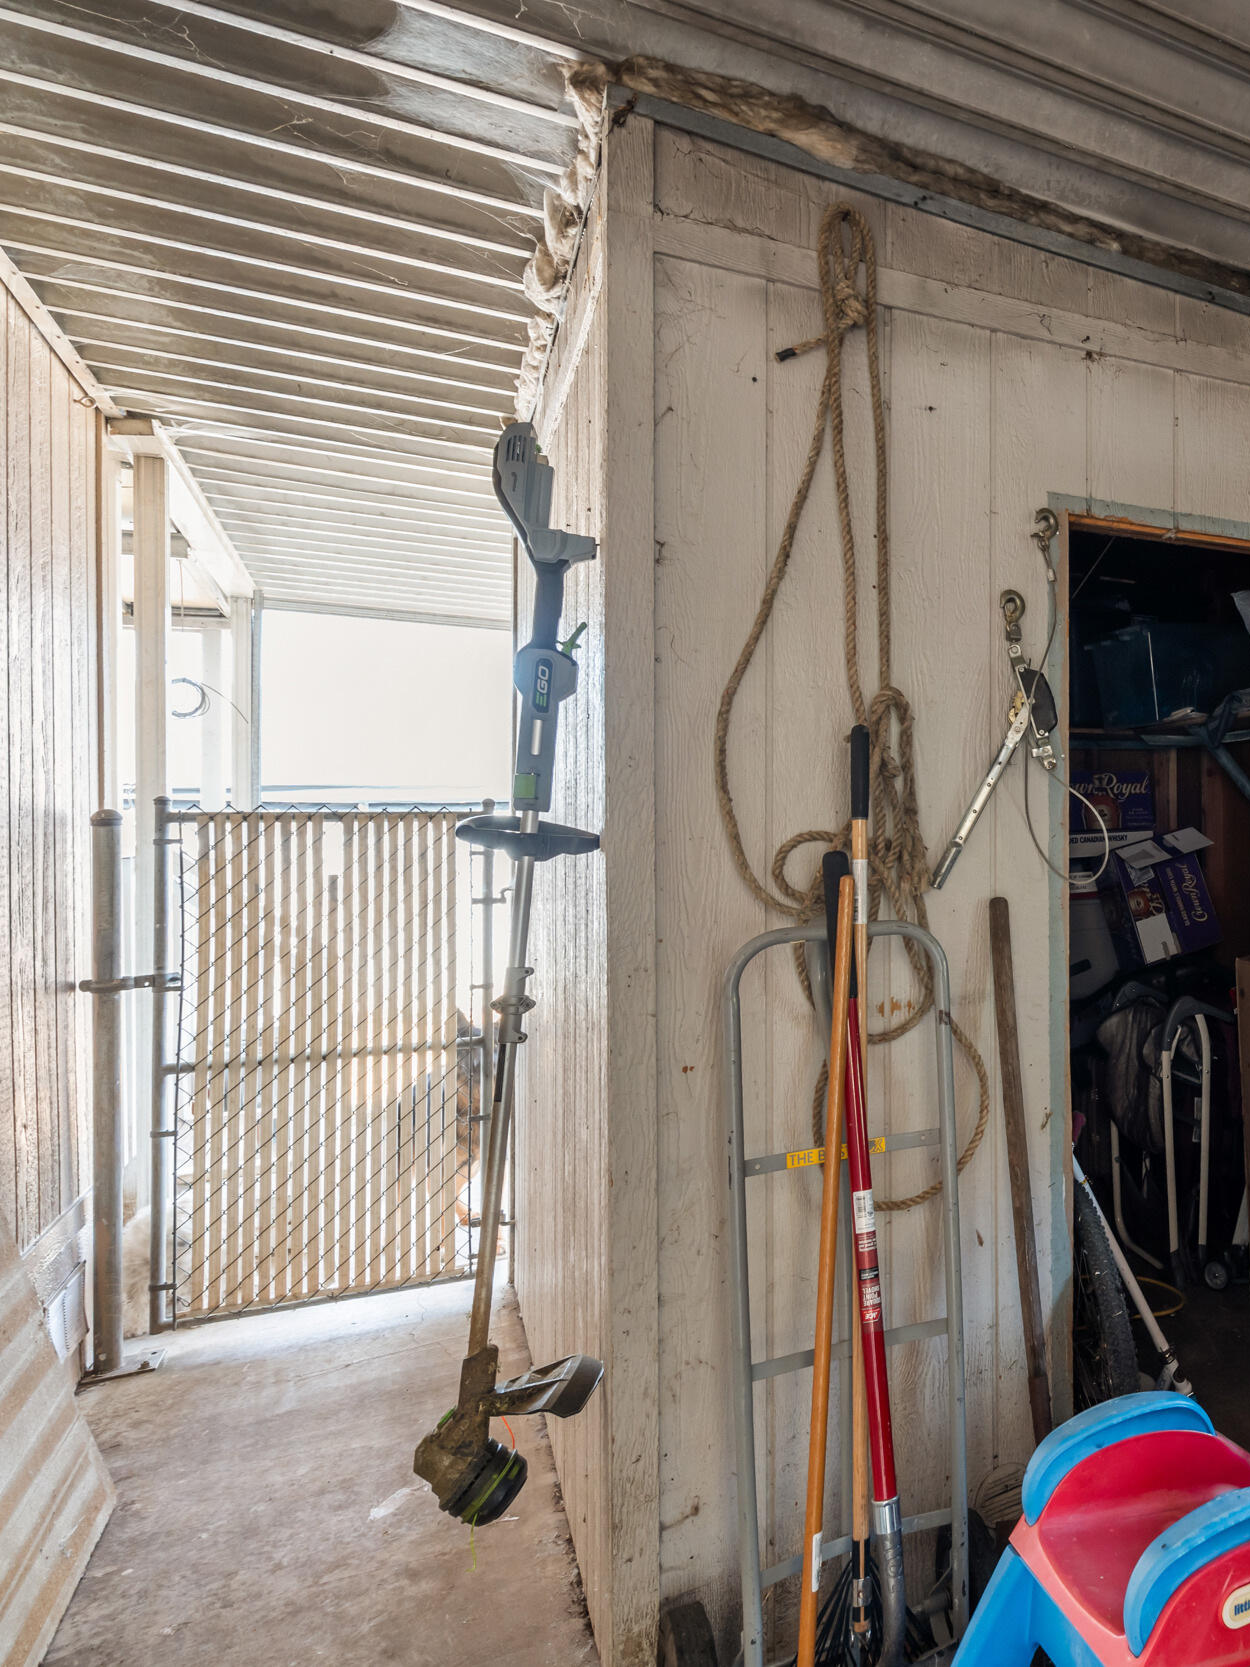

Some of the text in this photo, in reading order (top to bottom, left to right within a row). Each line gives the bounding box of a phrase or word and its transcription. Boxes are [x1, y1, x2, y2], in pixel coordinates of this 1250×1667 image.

[535, 665, 549, 707] EGO
[1102, 772, 1149, 802] Royal
[789, 1151, 814, 1166] THE
[864, 1311, 878, 1319] ACE
